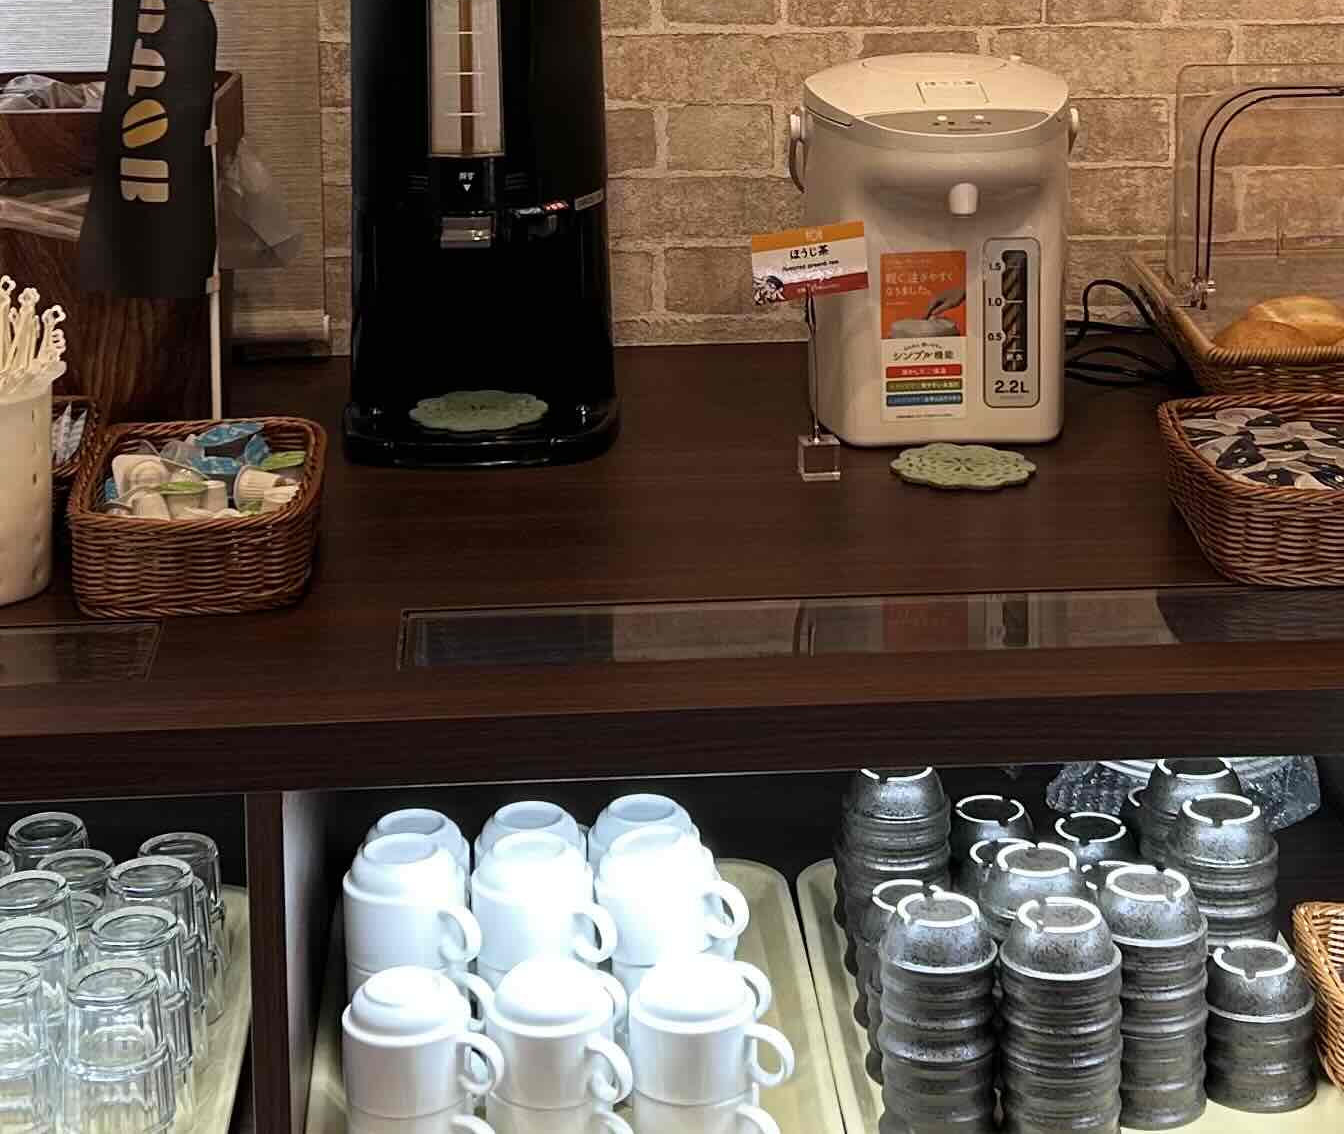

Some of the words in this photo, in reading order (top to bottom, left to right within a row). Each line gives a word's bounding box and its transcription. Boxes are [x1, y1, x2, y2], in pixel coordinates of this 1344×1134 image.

[790, 245, 829, 260] ほうじ茶
[987, 297, 1002, 307] 1.0
[987, 332, 1002, 341] 0.5
[994, 379, 1030, 394] 2.2L
